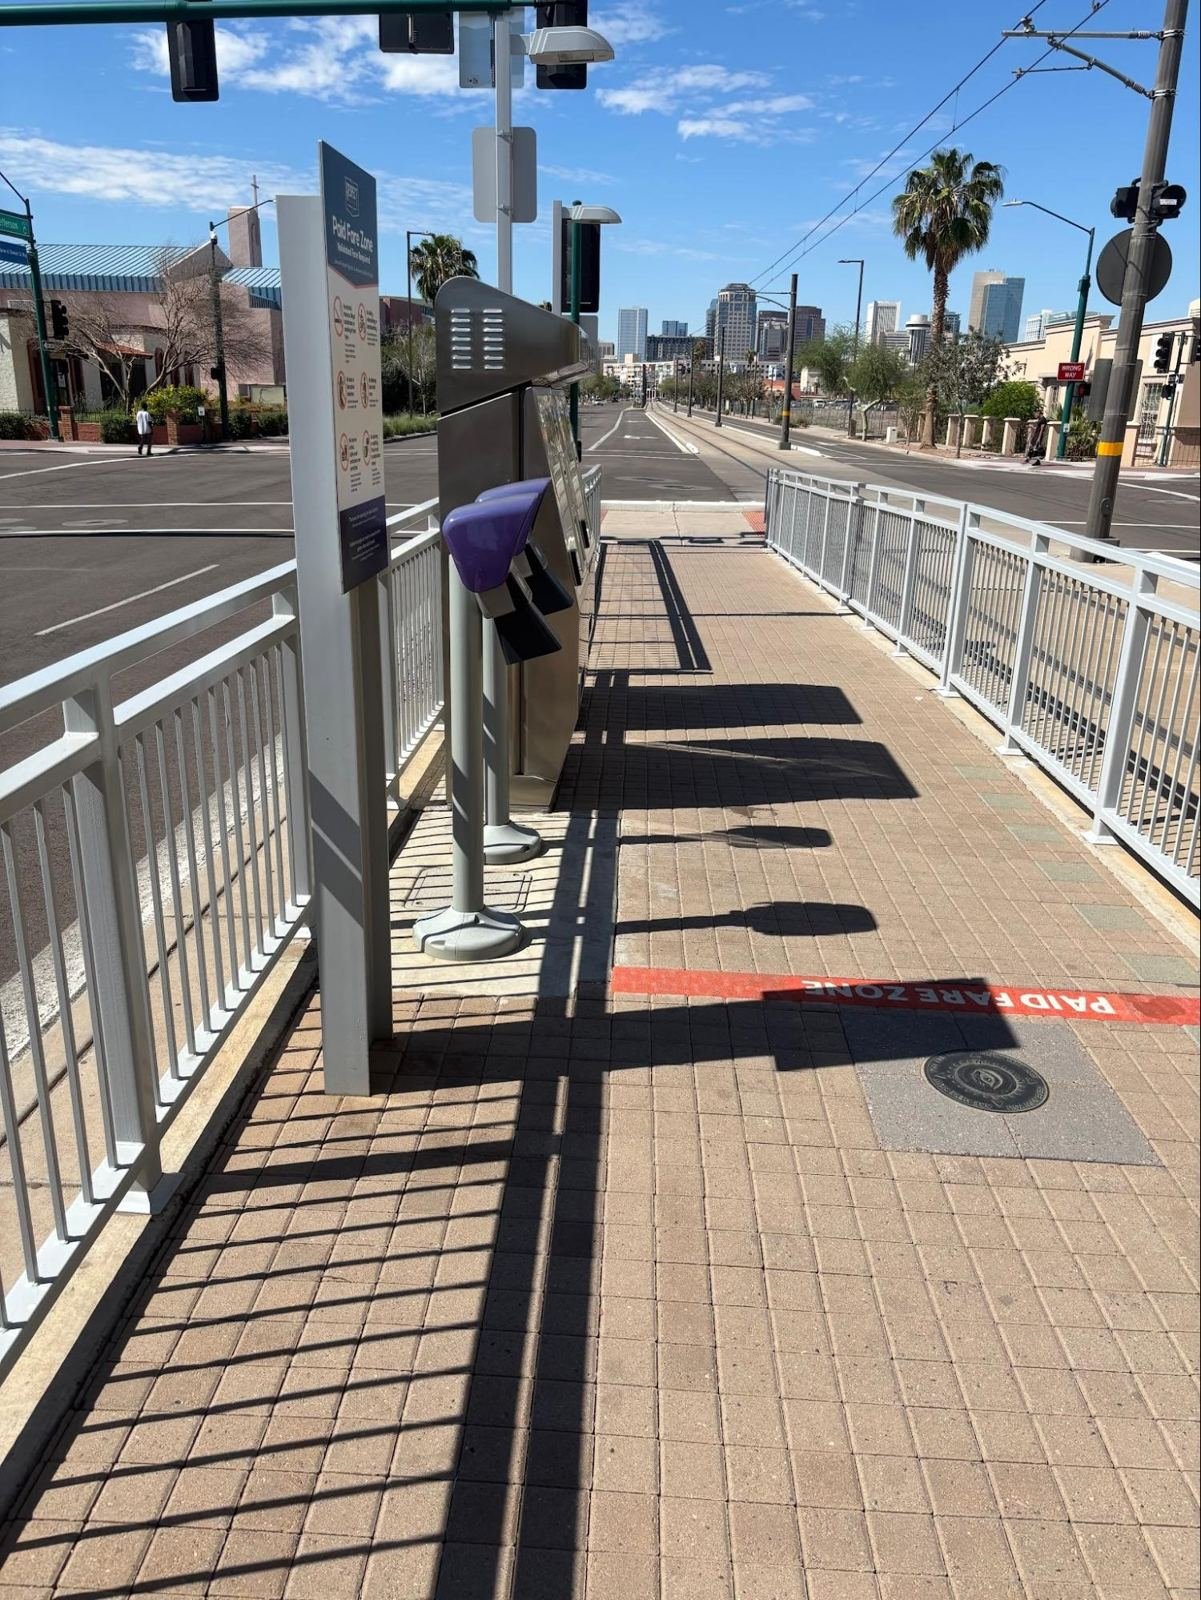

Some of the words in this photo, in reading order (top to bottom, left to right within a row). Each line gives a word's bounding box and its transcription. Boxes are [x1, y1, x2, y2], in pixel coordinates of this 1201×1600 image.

[332, 215, 346, 240] Paid
[347, 223, 360, 247] Fare
[360, 230, 374, 253] Zone
[802, 980, 909, 999] ZONE
[917, 987, 1014, 1007] FARE
[1019, 993, 1116, 1014] PAID
